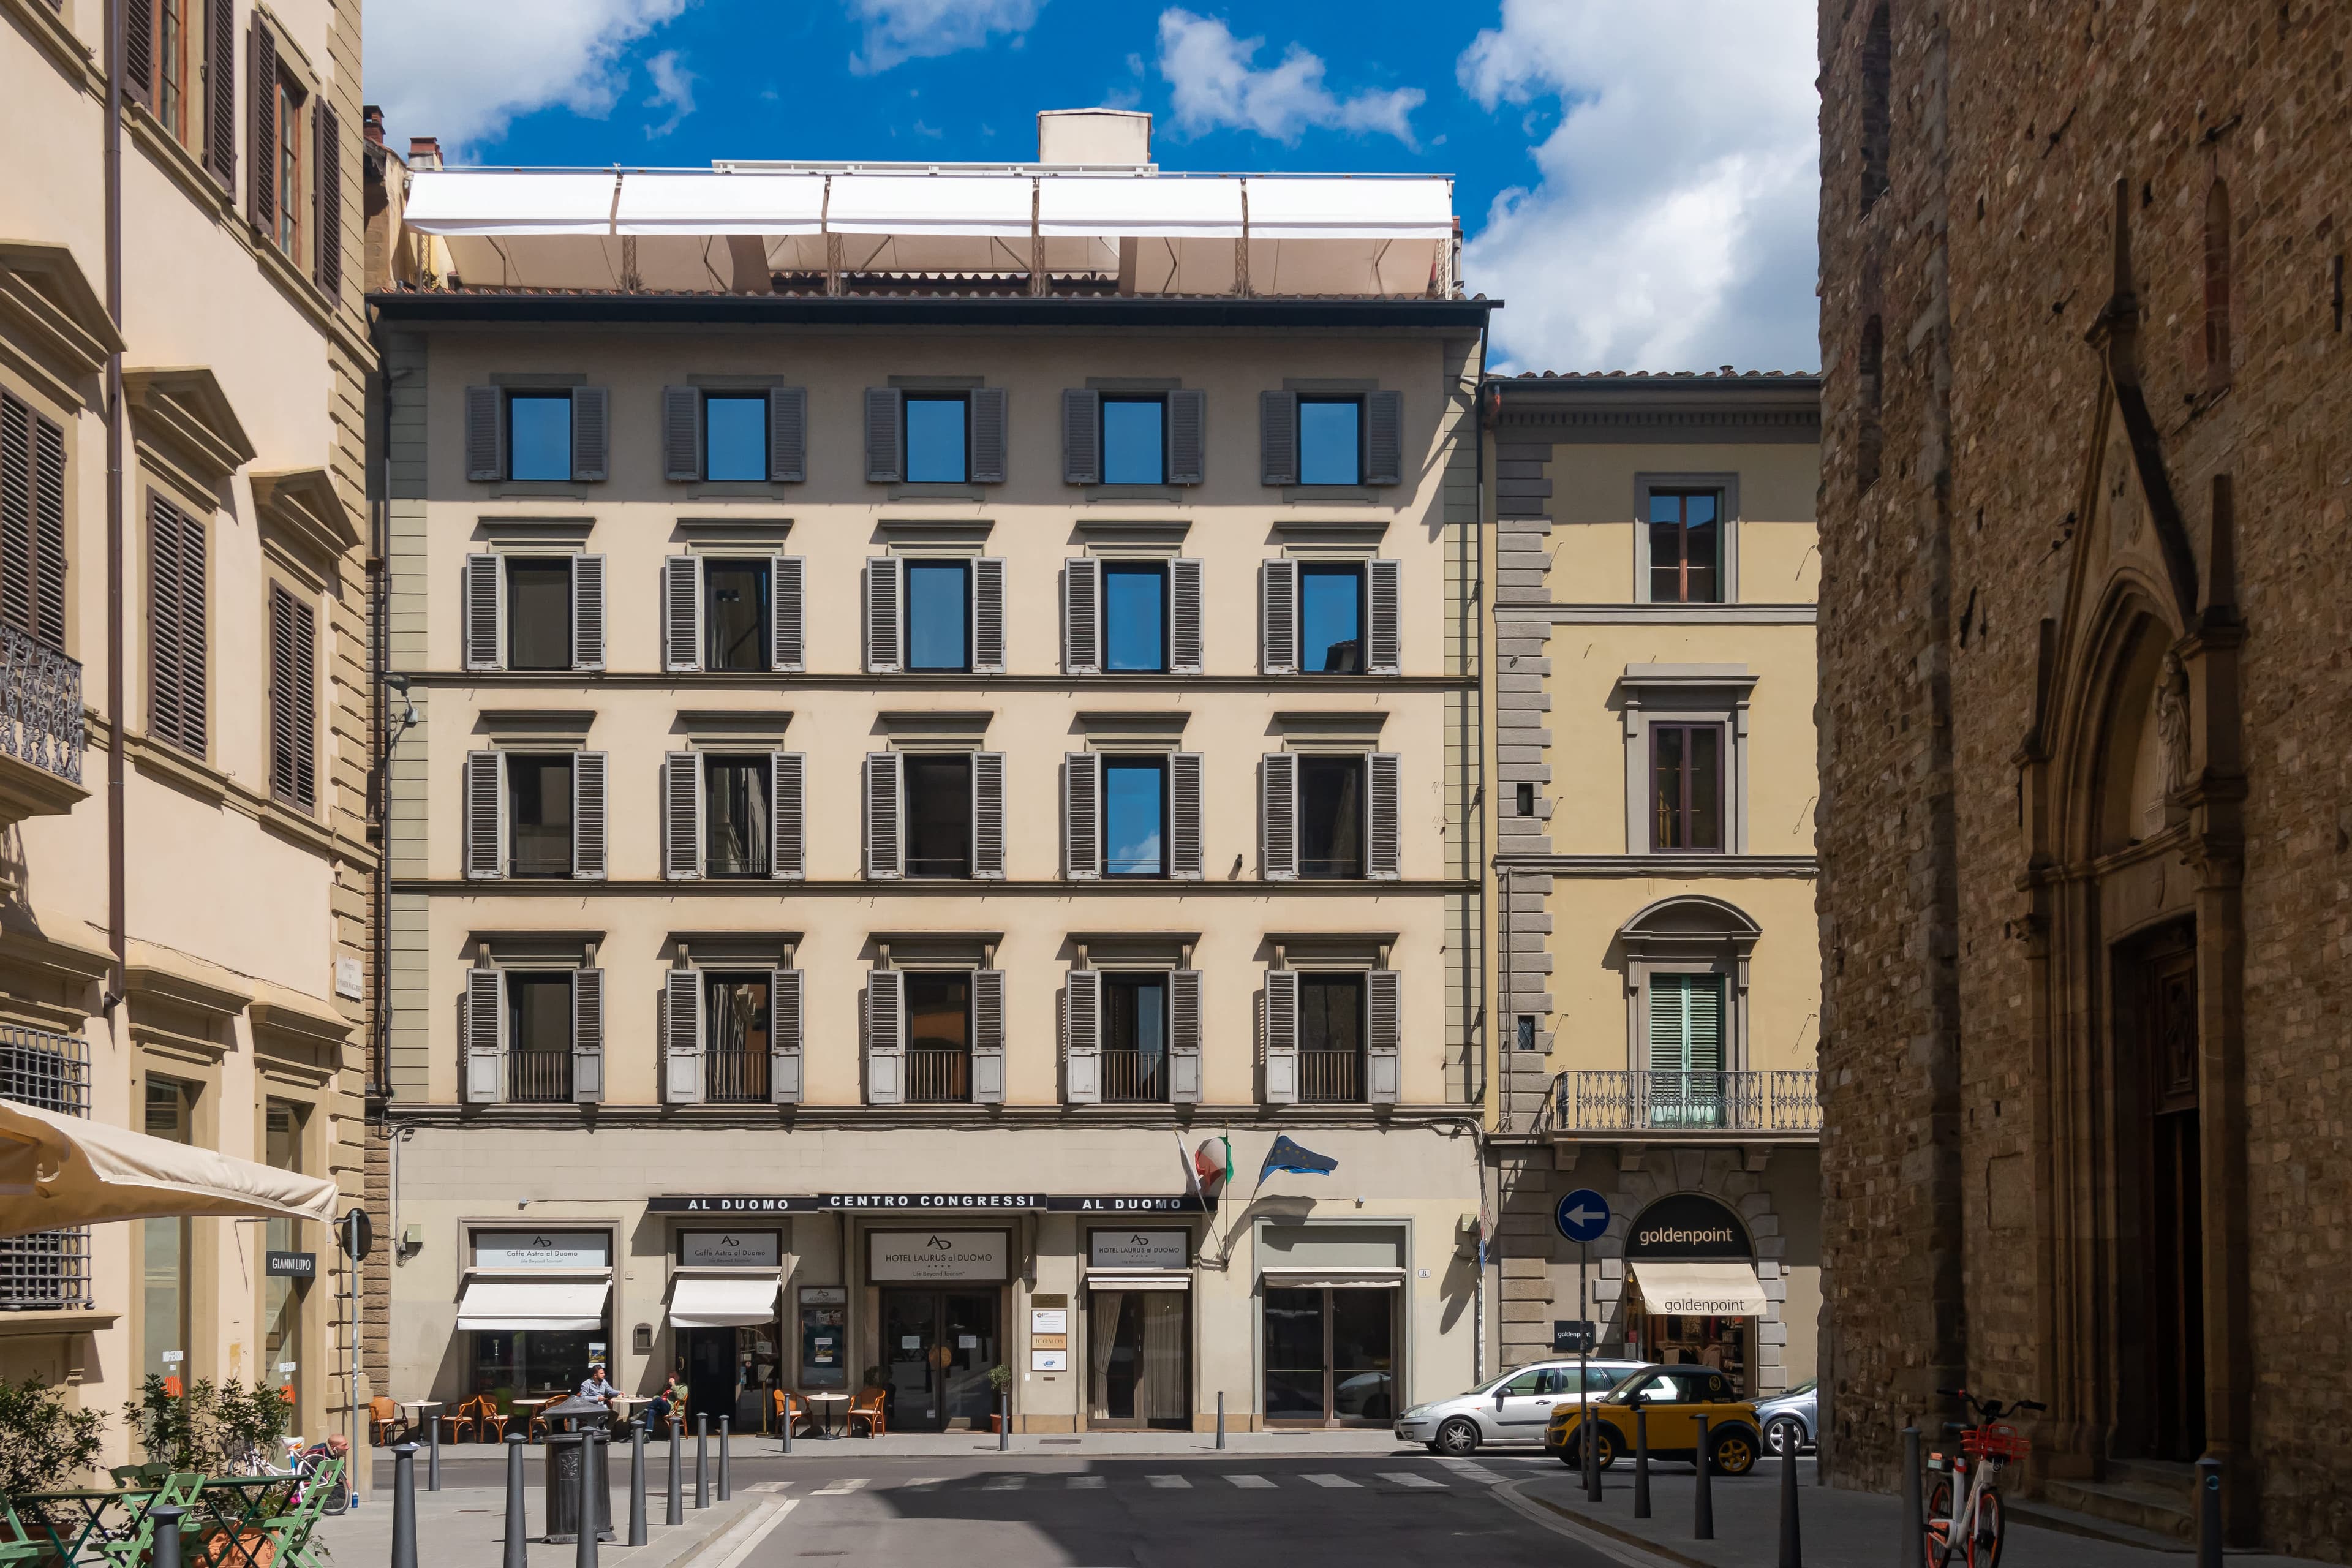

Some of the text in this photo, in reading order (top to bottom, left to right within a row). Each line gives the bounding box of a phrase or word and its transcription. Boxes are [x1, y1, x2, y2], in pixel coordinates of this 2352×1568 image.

[688, 1200, 788, 1210] AL DUOMO
[831, 1196, 1034, 1206] CENTRO CONGRESSI
[1082, 1199, 1181, 1209] AL DUOMO
[1640, 1227, 1733, 1245] goldenpoint
[272, 1258, 311, 1270] GIANNI LUPO
[1665, 1298, 1745, 1314] goldenpoint
